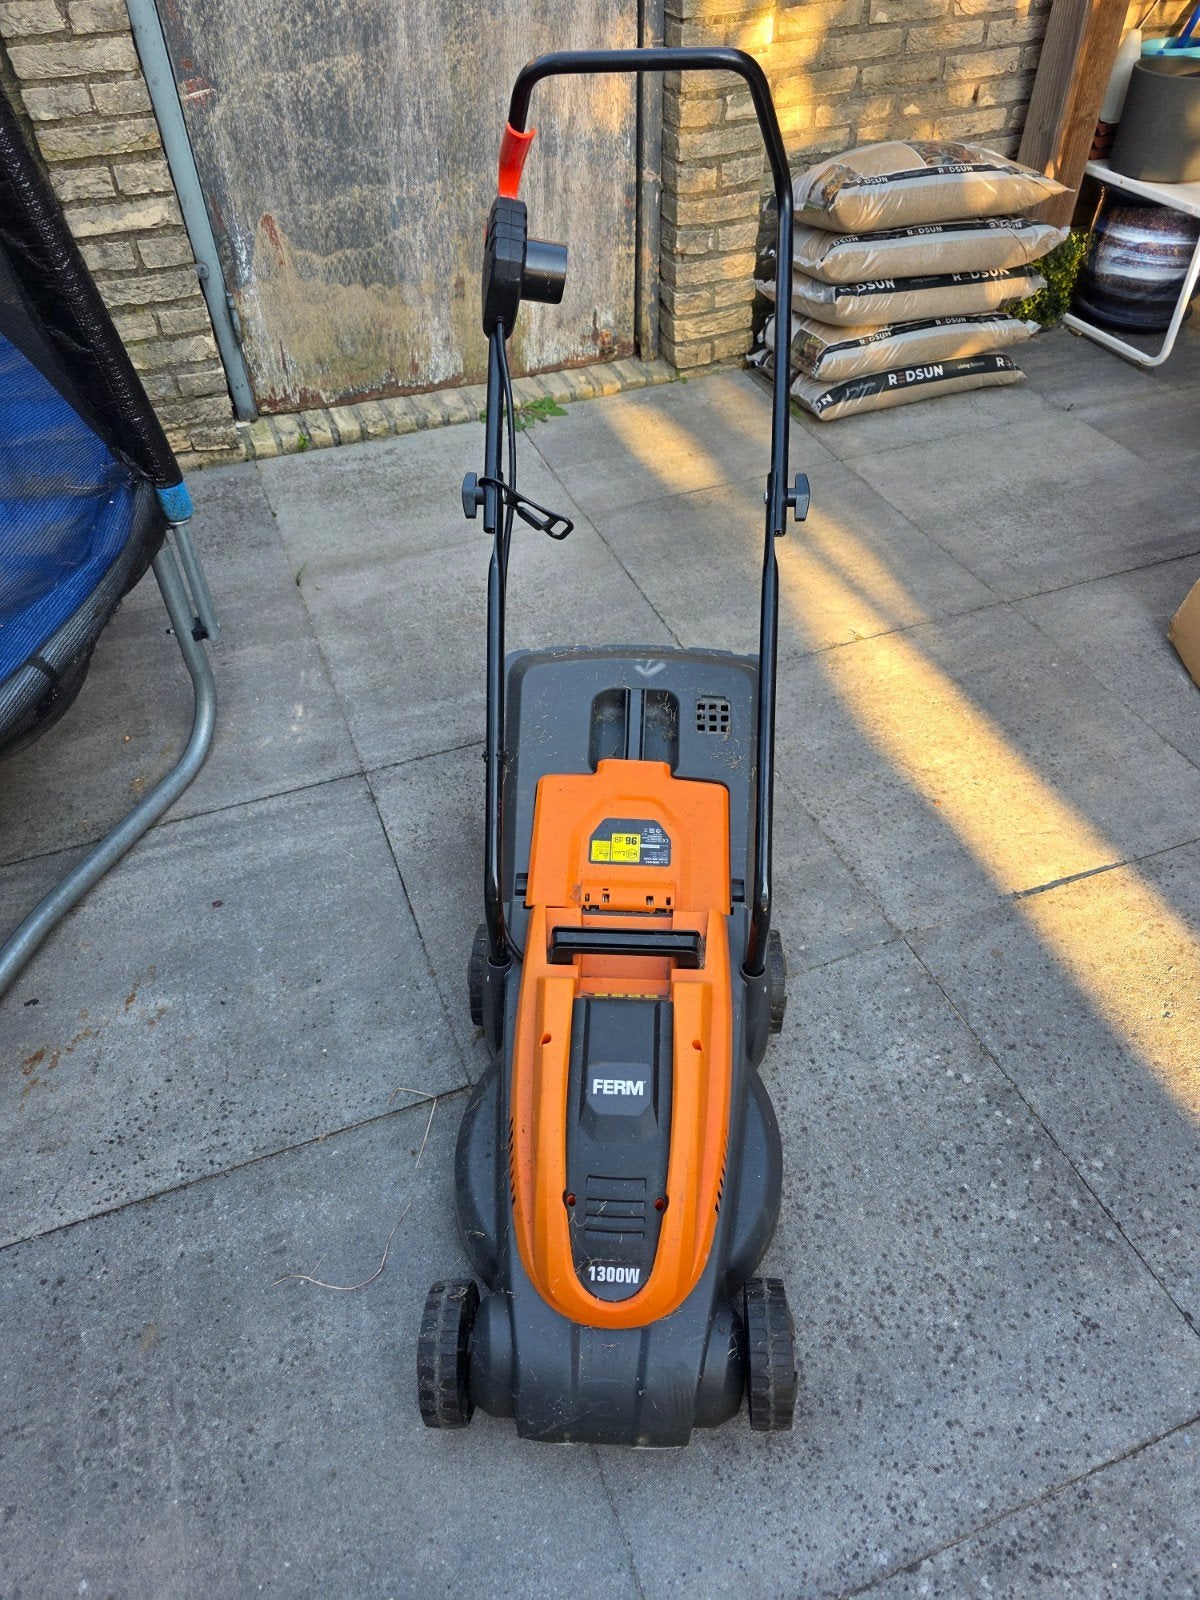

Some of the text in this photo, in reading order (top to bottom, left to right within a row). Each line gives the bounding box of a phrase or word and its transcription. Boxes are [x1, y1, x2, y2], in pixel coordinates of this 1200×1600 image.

[888, 364, 944, 386] REDSUN
[625, 836, 637, 846] 96
[592, 1078, 644, 1096] FERM
[588, 1265, 641, 1284] 1300W
